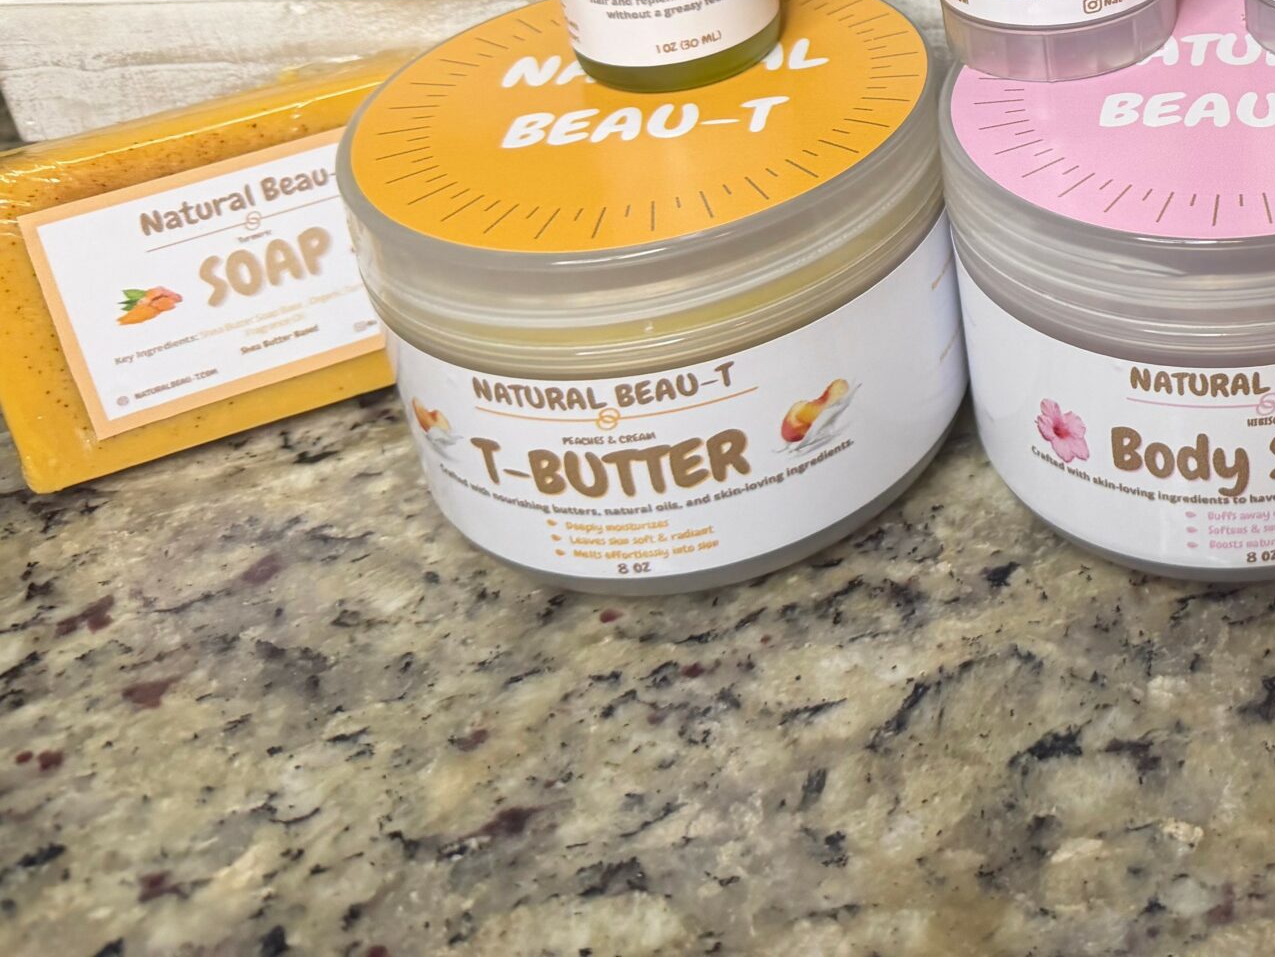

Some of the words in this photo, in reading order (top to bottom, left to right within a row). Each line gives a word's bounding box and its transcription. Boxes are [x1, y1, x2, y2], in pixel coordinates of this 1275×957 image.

[606, 7, 651, 20] without
[654, 9, 662, 18] a
[664, 1, 702, 19] greasy
[656, 44, 661, 55] 1
[663, 42, 677, 54] OZ
[680, 39, 700, 53] (30
[701, 30, 722, 48] ML)
[500, 95, 790, 150] BEAU-T
[139, 183, 255, 237] Natural
[260, 166, 336, 202] Beau-
[198, 225, 334, 308] SOAP
[114, 354, 134, 366] Key
[136, 332, 201, 359] Ingredients:
[472, 376, 607, 411] NATURAL
[614, 360, 735, 407] BEAU-T
[1130, 366, 1271, 398] NATURAL
[470, 428, 751, 498] T-BUTTER
[562, 435, 605, 446] PEACHES
[608, 435, 616, 445] &
[618, 432, 656, 444] CREAM
[1111, 426, 1250, 497] Body
[493, 491, 550, 514] nourishing
[552, 503, 601, 517] butters,
[604, 503, 652, 516] natural
[686, 493, 711, 508] and
[714, 470, 784, 502] skin-loving
[786, 439, 855, 478] ingredients.
[1031, 445, 1065, 471] Crafted
[1067, 466, 1091, 482] with
[1092, 476, 1155, 501] skin-loving
[1157, 490, 1230, 505] ingredients
[1233, 495, 1247, 505] to
[617, 562, 629, 574] 8
[633, 561, 651, 574] OZ
[1246, 551, 1257, 563] 8
